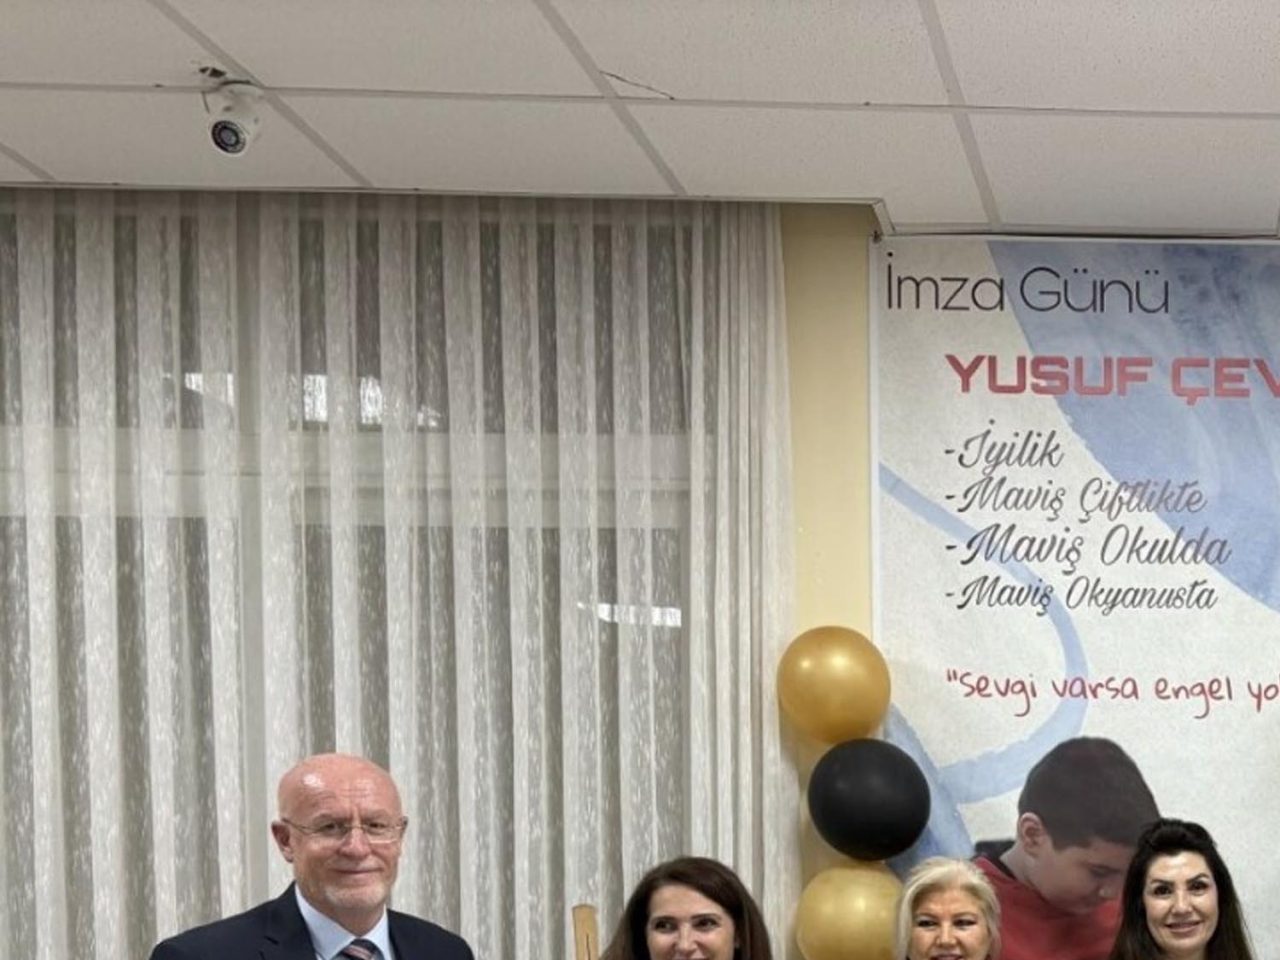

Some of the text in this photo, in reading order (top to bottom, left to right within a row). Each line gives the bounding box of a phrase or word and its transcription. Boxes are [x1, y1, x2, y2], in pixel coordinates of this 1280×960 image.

[886, 252, 1170, 314] İmza Günü
[945, 354, 1153, 396] YUSUF
[1078, 478, 1208, 523] Çiftlikte
[1100, 524, 1232, 567] Okulda
[1066, 577, 1218, 616] Okyanusta
[946, 669, 1037, 717] "sevgi
[1052, 678, 1140, 701] varsa
[1154, 676, 1233, 719] engel
